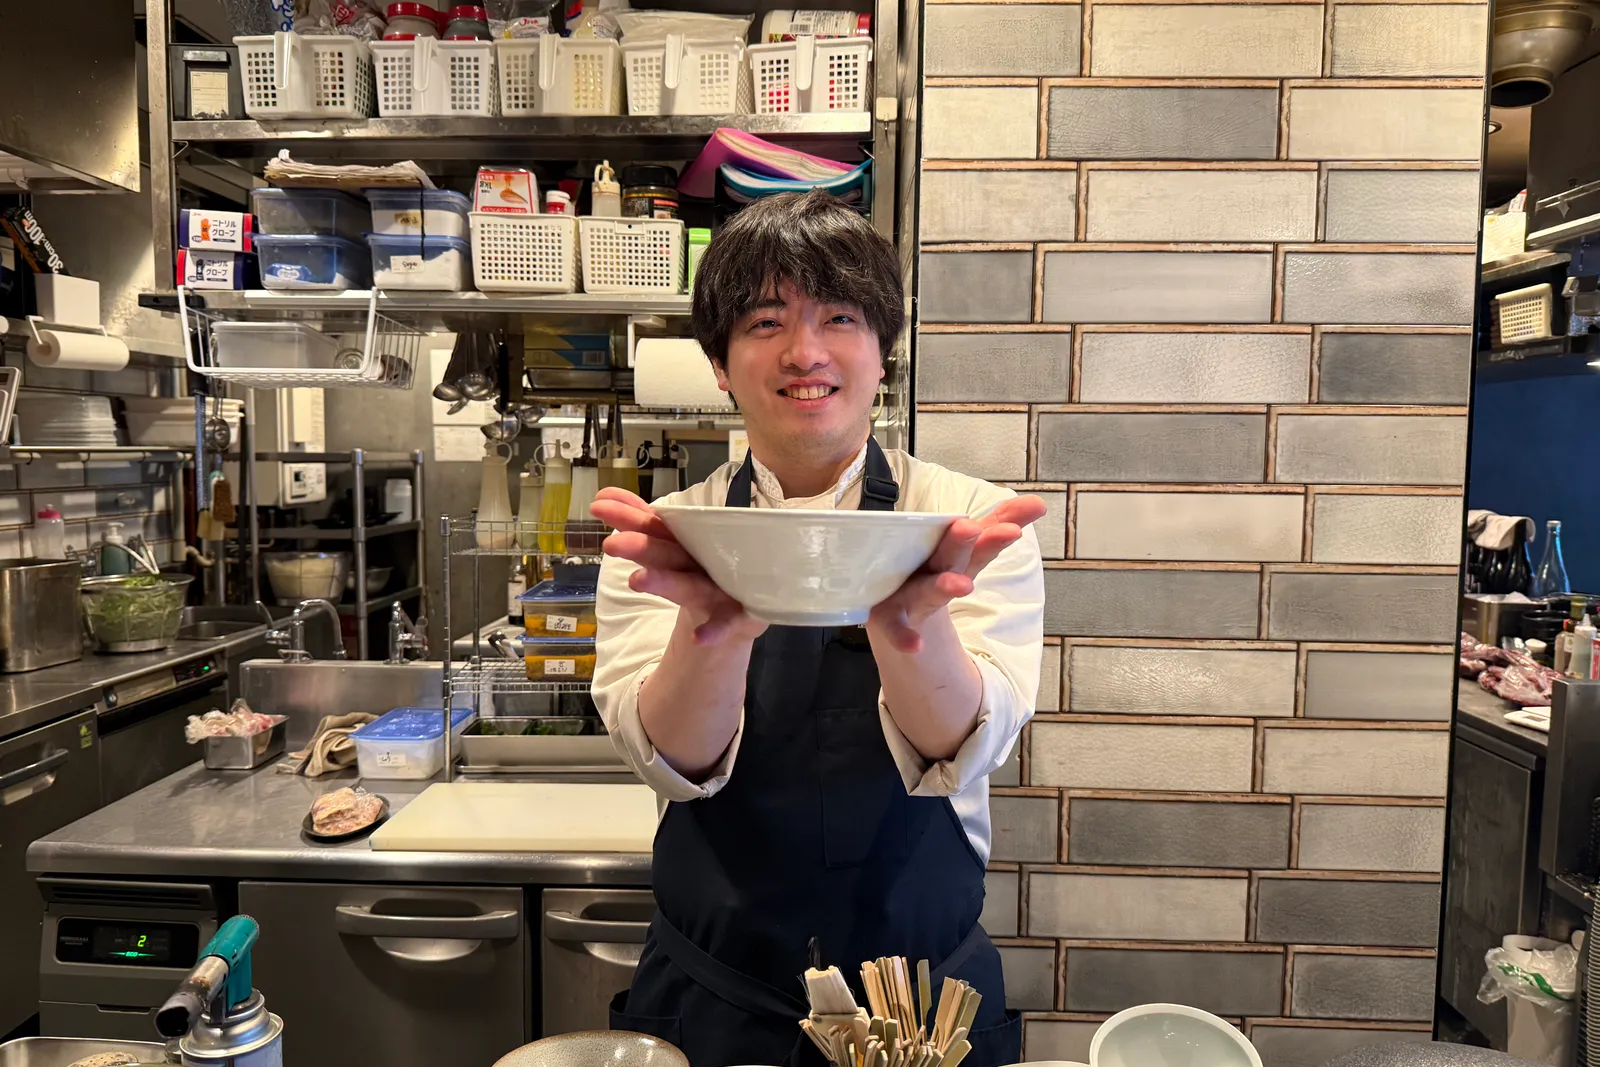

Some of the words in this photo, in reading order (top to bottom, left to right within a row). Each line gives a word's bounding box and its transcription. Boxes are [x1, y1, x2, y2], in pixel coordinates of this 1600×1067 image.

[212, 219, 236, 228] ニトリル
[212, 228, 236, 237] グローブ
[205, 269, 228, 277] グローブ
[137, 935, 147, 948] 2
